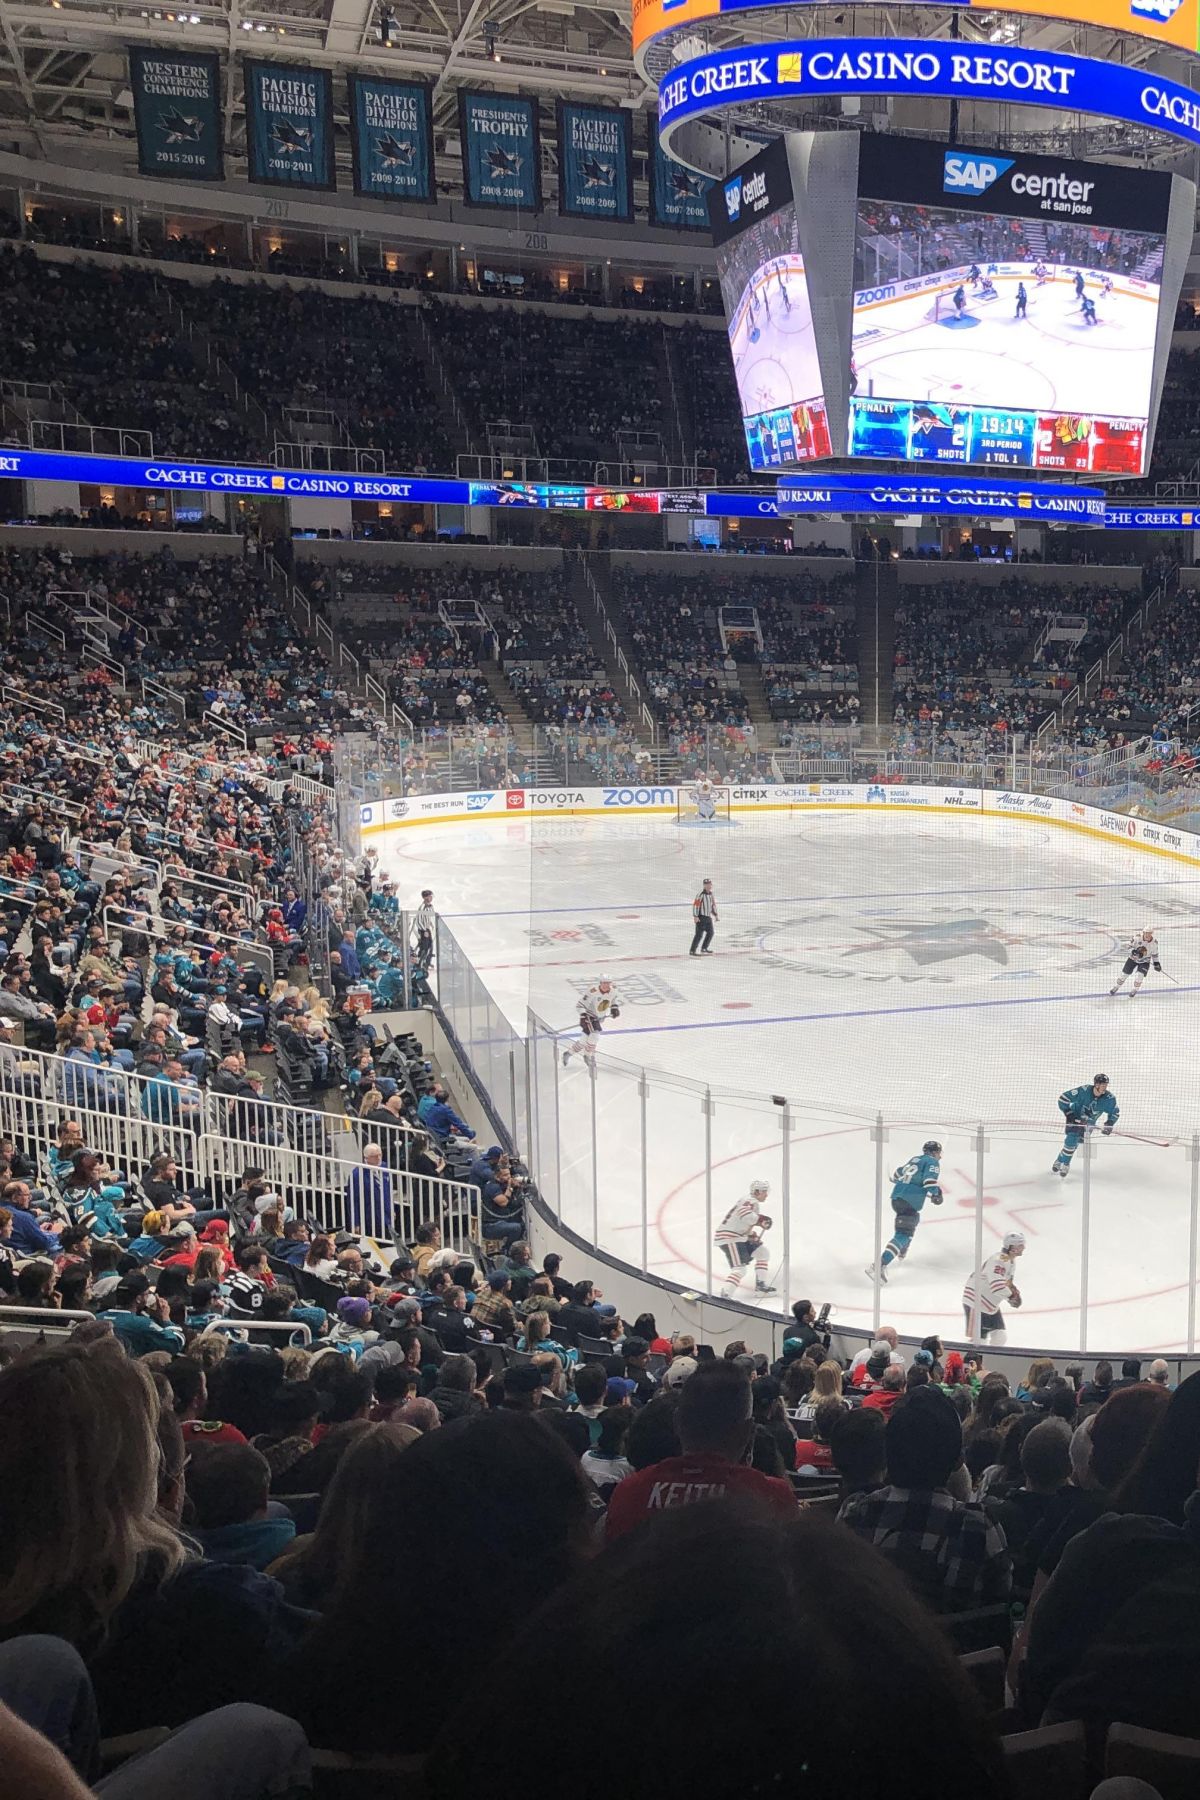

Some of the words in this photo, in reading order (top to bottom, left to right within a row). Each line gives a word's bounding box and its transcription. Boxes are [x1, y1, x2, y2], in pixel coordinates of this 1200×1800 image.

[142, 60, 208, 79] WESTERN
[691, 57, 771, 98] CREEK
[808, 52, 941, 83] CASINO
[951, 56, 1075, 96] RESORT
[143, 75, 210, 89] CONFERENCE
[261, 77, 316, 97] PACIFIC
[144, 84, 209, 99] CHAMPIONS
[262, 91, 316, 108] DIVISION
[364, 92, 417, 111] PACIFIC
[262, 102, 317, 118] CHAMPIONS
[365, 106, 417, 122] DIVISION
[472, 108, 528, 123] PRESIDENTS
[366, 117, 418, 131] CHAMPIONS
[471, 118, 529, 137] TROPHY
[572, 117, 618, 135] PACIFIC
[572, 130, 618, 146] DIVISION
[572, 140, 619, 154] CHAMPIONS
[268, 158, 313, 173] 2010-2011
[371, 172, 417, 186] 2009-2010
[944, 158, 998, 190] SAP
[1010, 172, 1095, 202] center
[480, 185, 524, 199] 2008-2009
[725, 186, 740, 216] SAP
[742, 172, 766, 205] center
[1040, 199, 1051, 212] at
[1052, 201, 1071, 213] san
[1071, 202, 1093, 216] jose
[525, 232, 548, 251] 208
[856, 284, 896, 306] zoom
[856, 402, 896, 414] PENALTY
[980, 416, 1025, 435] 19:14
[1109, 420, 1144, 432] PENALTY
[952, 423, 965, 446] 2
[1039, 430, 1052, 452] 2
[996, 440, 1023, 450] PERIOD
[913, 448, 924, 458] 21
[937, 448, 965, 460] SHOTS
[1039, 455, 1065, 466] SHOTS
[1075, 458, 1087, 468] 23
[0, 457, 20, 471] RT
[145, 468, 208, 486] CACHE
[210, 471, 269, 489] CREEK
[288, 477, 350, 495] CASINO
[354, 481, 412, 497] RESORT
[758, 501, 778, 513] CA
[870, 486, 941, 504] CACHE
[945, 488, 1015, 508] CREEK
[1034, 495, 1085, 513] CASINO
[1104, 512, 1132, 524] CHE
[1135, 512, 1179, 525] CREEK
[529, 792, 585, 804] TOYOTA
[603, 787, 675, 806] zoom
[822, 788, 855, 797] CREEK
[433, 801, 449, 809] BEST
[450, 800, 464, 808] RUN
[467, 794, 488, 810] SAP
[996, 793, 1025, 806] Alaska
[1028, 797, 1053, 810] Alaska
[1100, 814, 1128, 833] SAFEWAY
